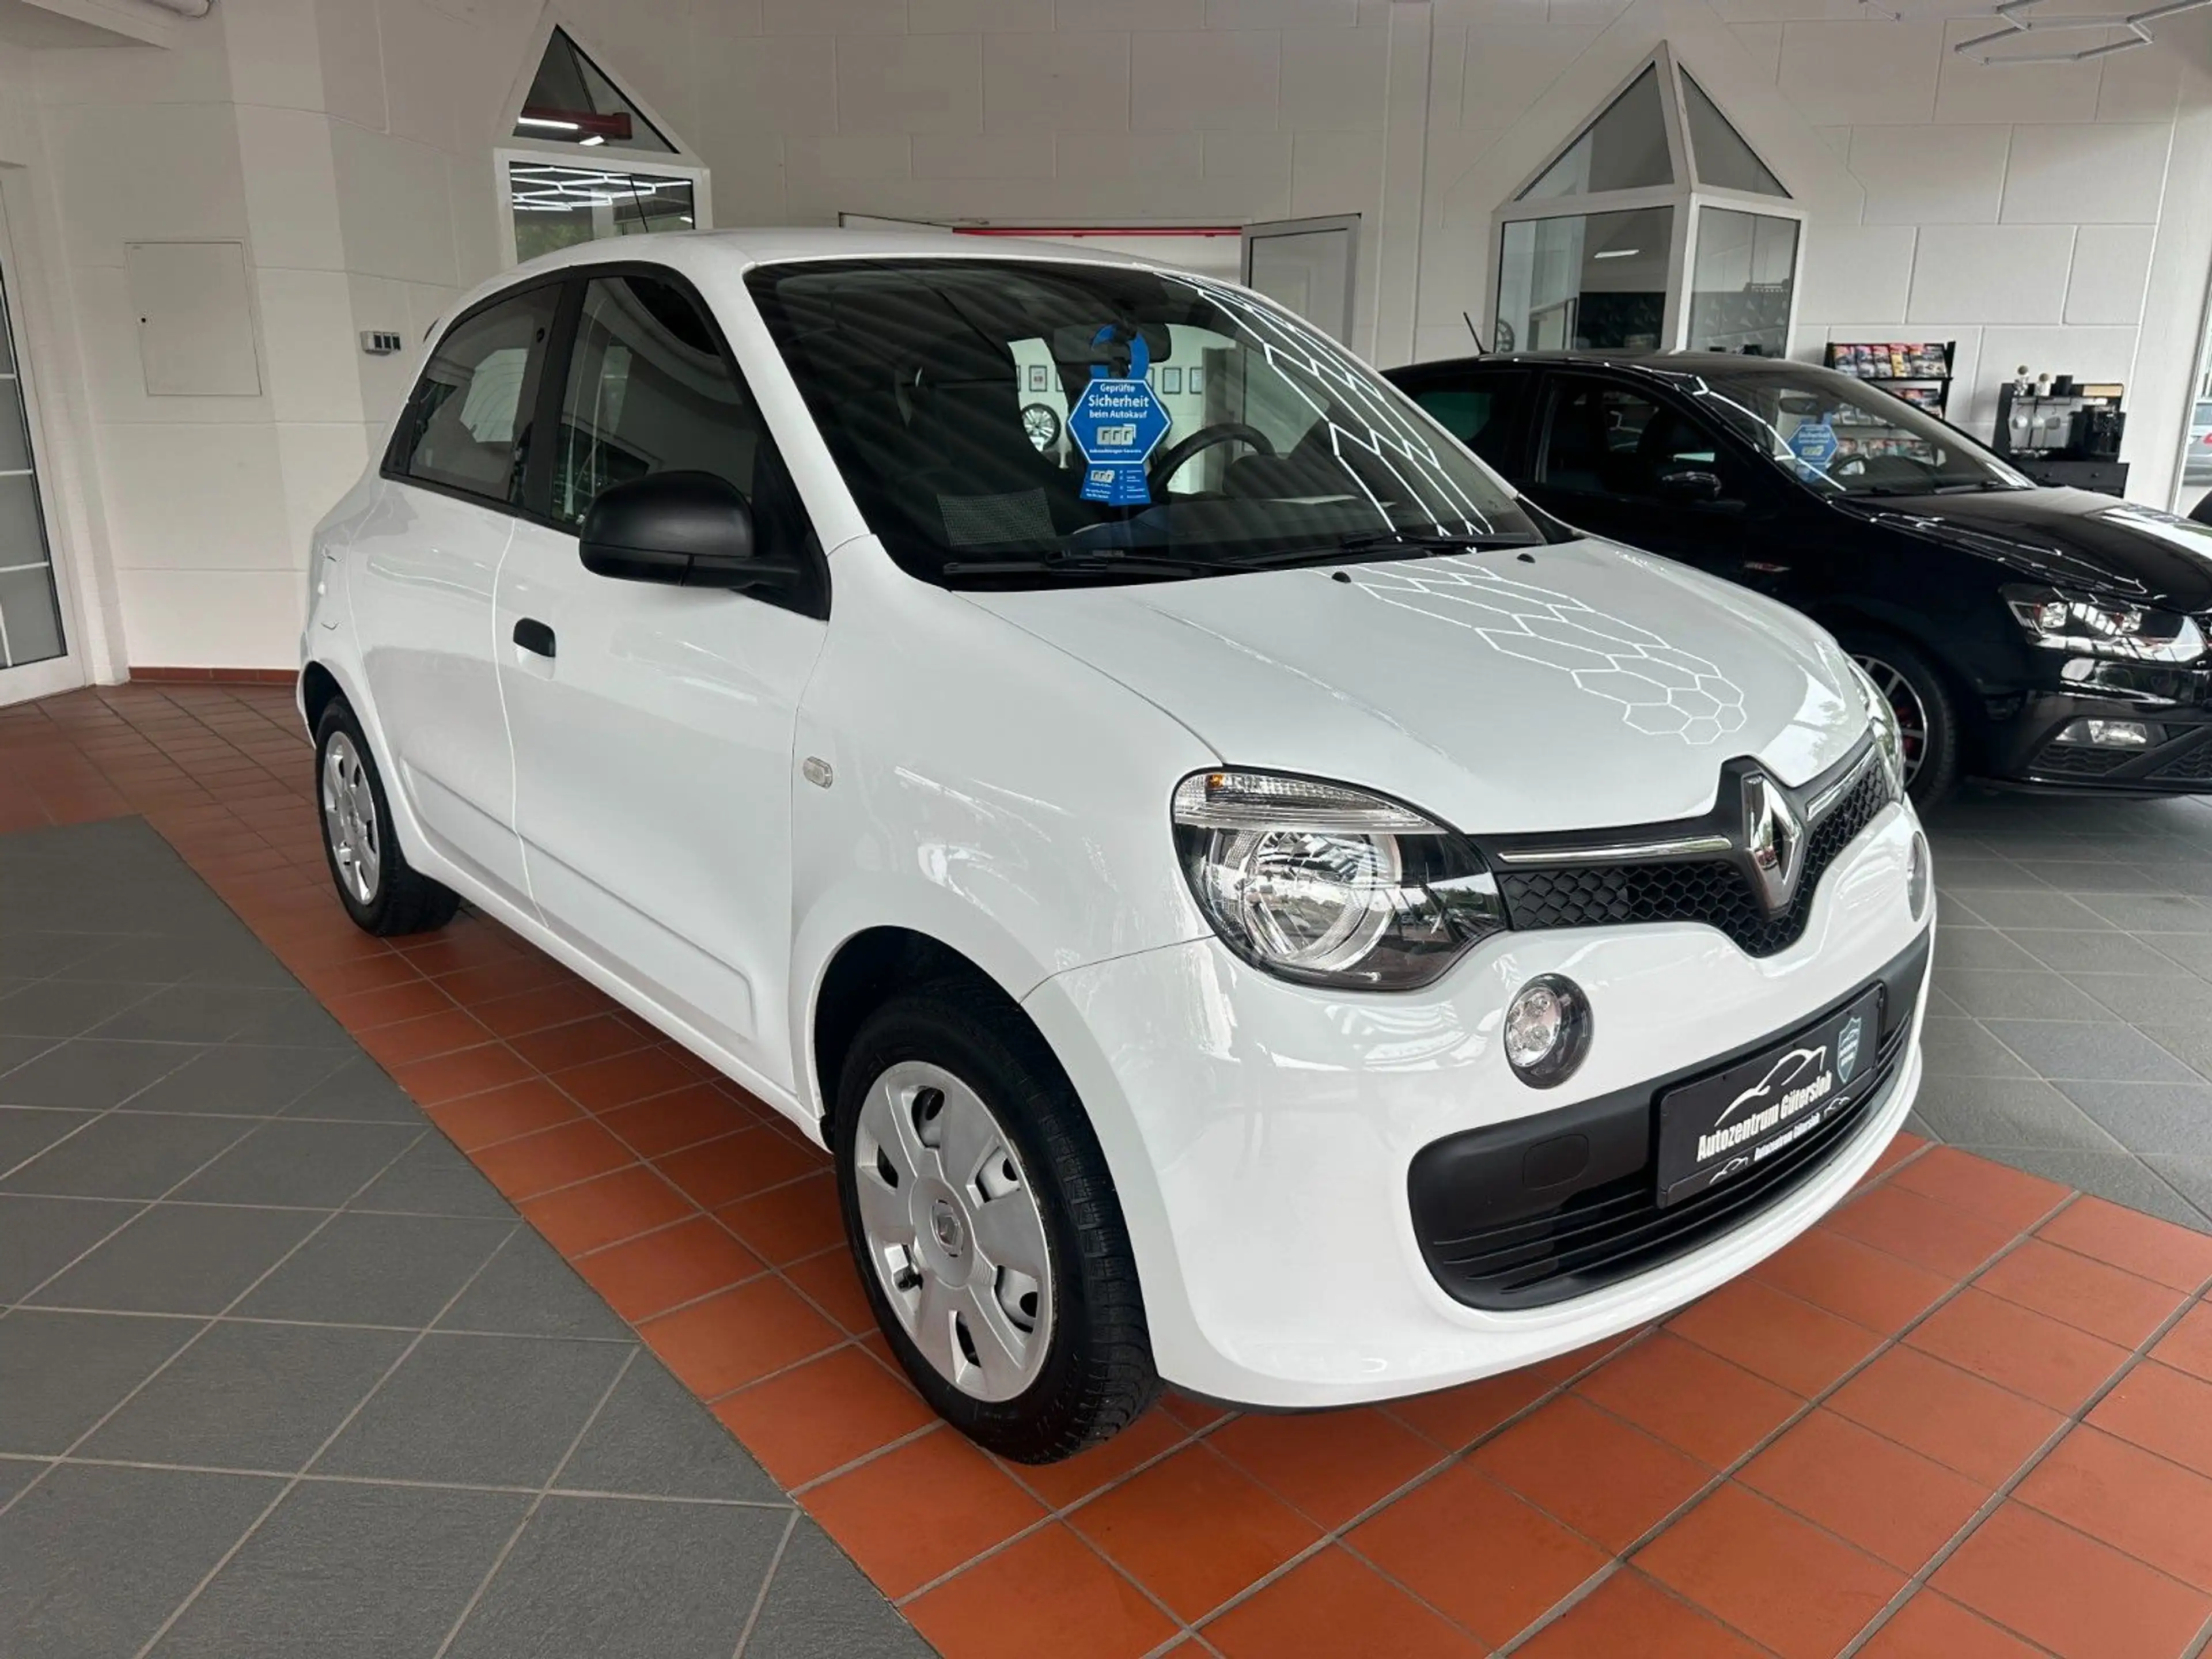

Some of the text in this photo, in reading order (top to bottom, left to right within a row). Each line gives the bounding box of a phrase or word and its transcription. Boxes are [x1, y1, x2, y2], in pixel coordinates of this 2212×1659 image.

[1100, 383, 1136, 393] Geprüfte
[1088, 394, 1150, 407] Sicherheit
[1089, 410, 1147, 418] beim Autokauf
[1697, 1070, 1832, 1162] Autozentrum Gütersloh
